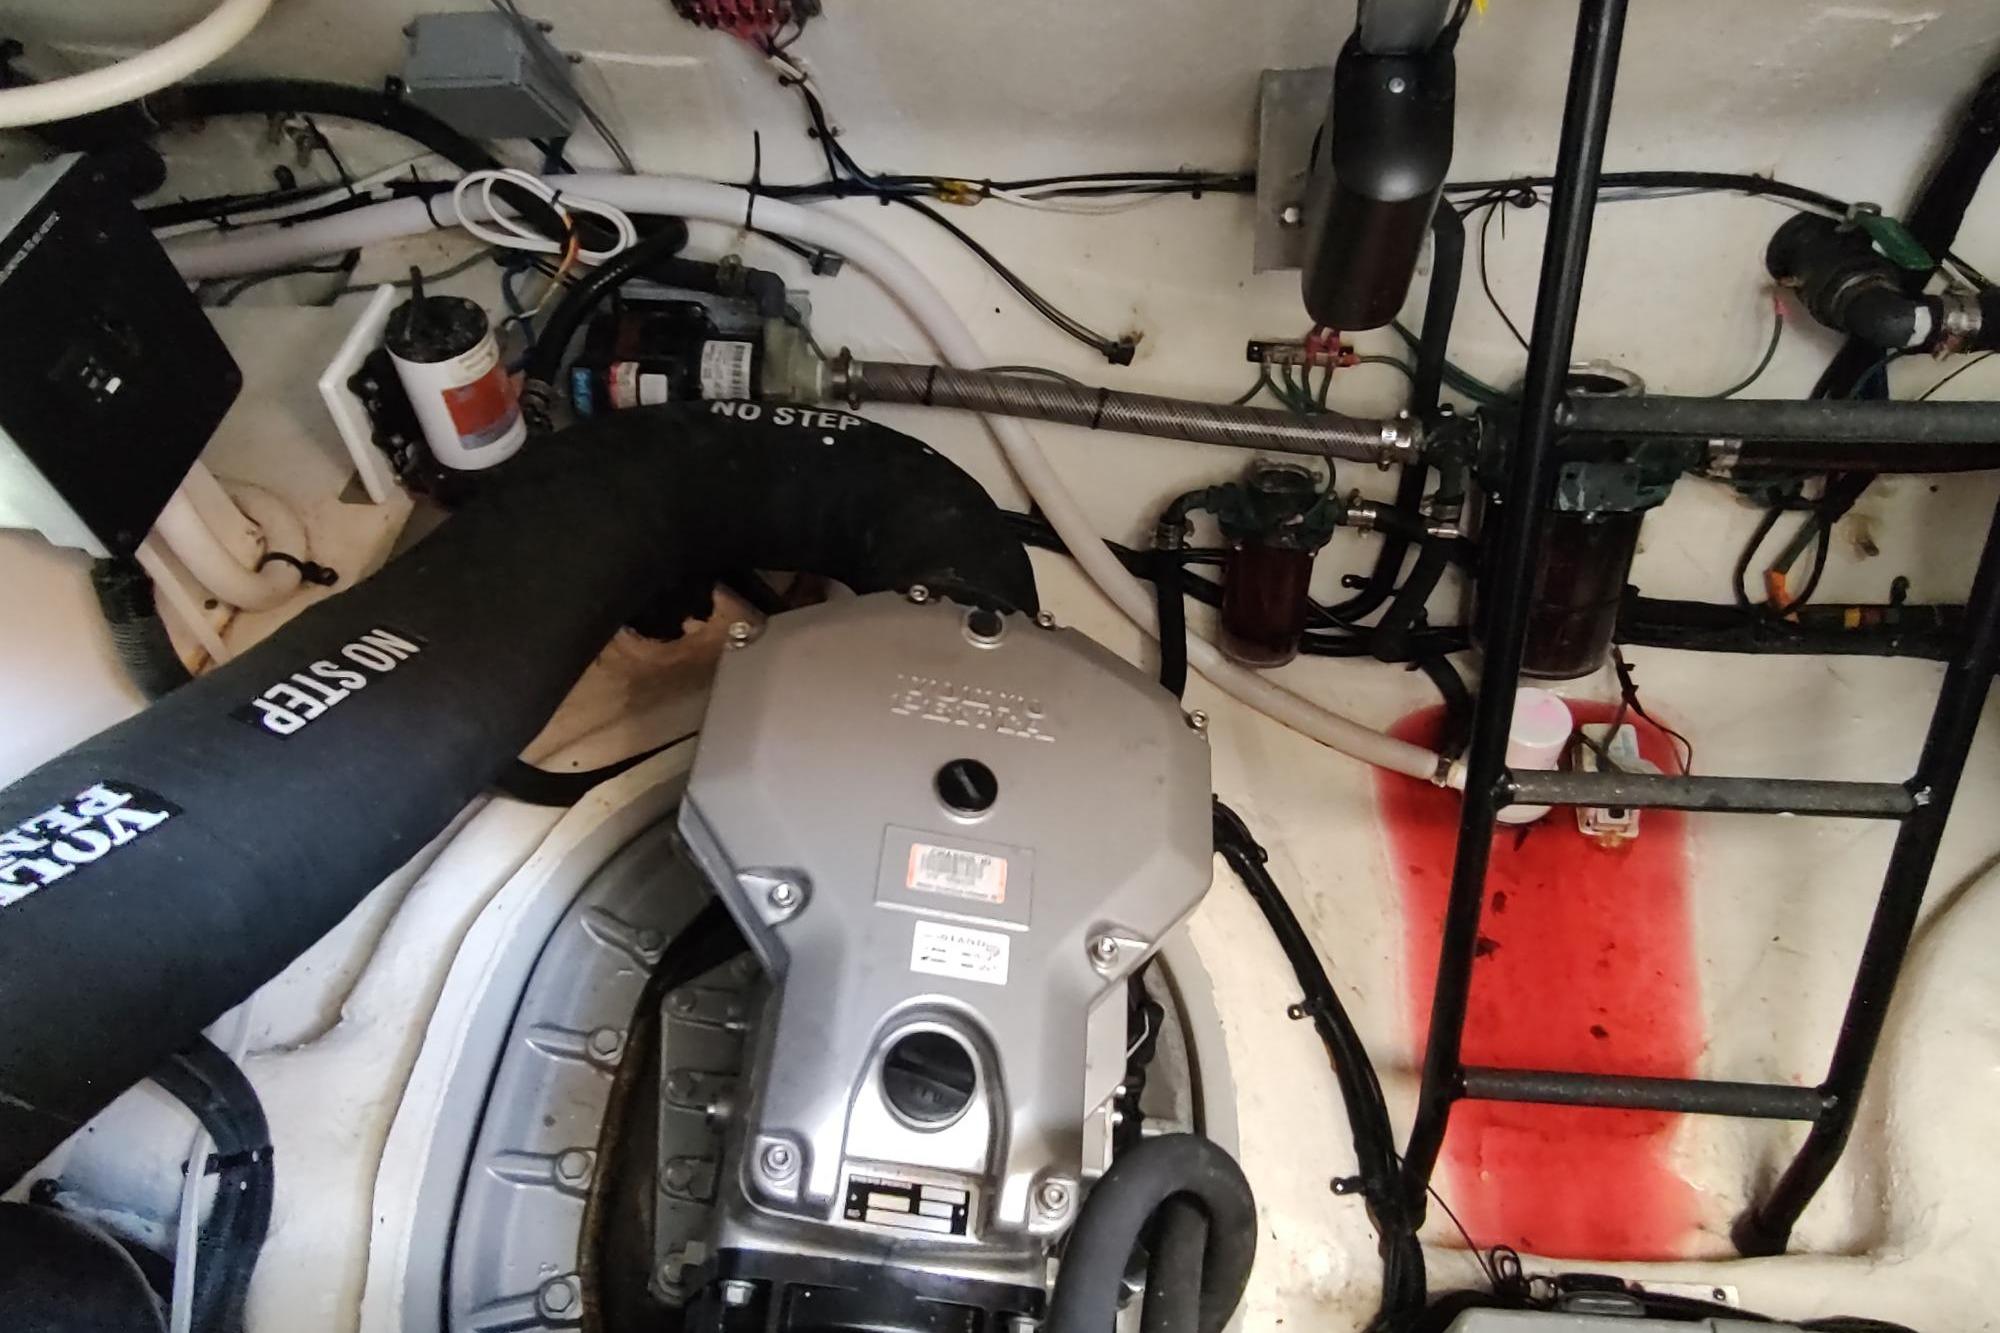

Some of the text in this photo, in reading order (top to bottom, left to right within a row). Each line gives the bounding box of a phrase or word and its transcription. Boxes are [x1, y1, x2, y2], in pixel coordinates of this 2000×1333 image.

[710, 401, 862, 431] NO STEP
[252, 628, 421, 735] NO STEP
